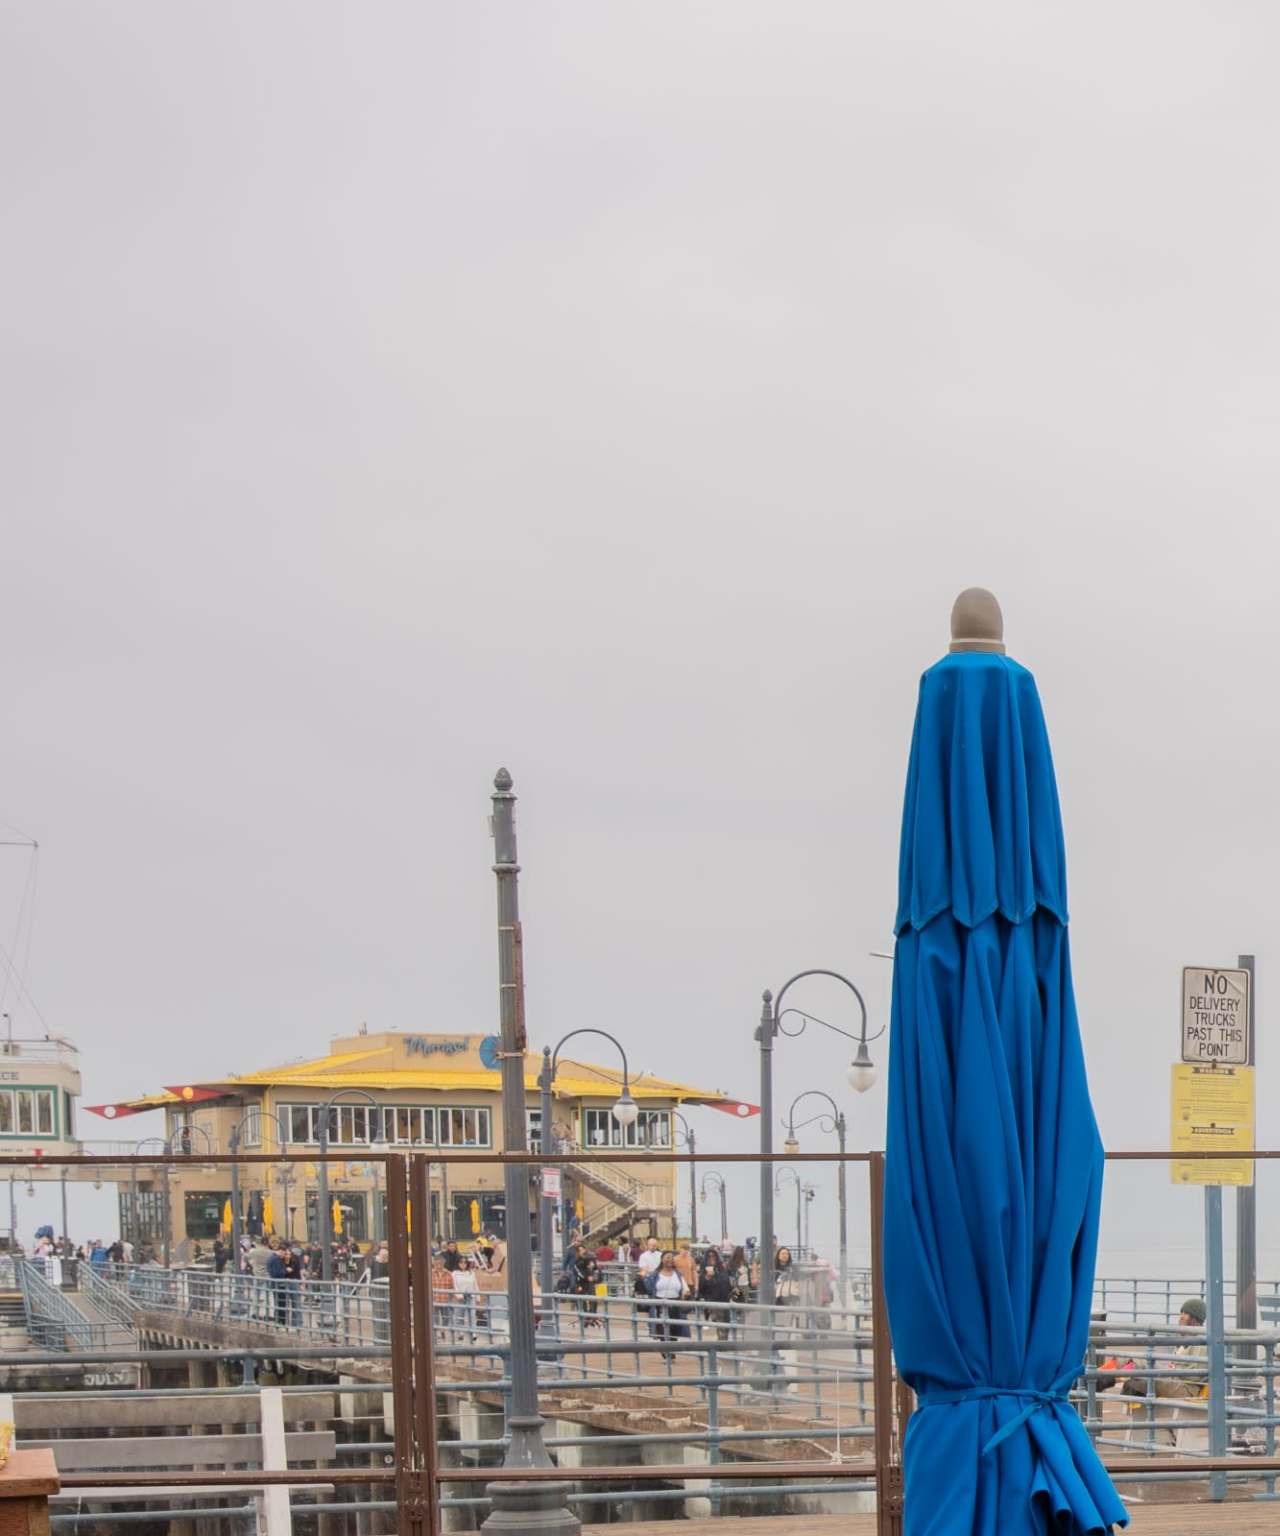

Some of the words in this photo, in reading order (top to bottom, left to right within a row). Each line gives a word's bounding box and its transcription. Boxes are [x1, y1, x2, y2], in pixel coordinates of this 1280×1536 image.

[1204, 975, 1228, 995] NO
[1189, 996, 1241, 1013] DELIVERY
[1194, 1012, 1236, 1027] TRUCKS
[1187, 1027, 1212, 1041] PAST
[1219, 1028, 1243, 1043] THIS
[1199, 1042, 1230, 1058] POINT
[0, 1072, 19, 1080] CE
